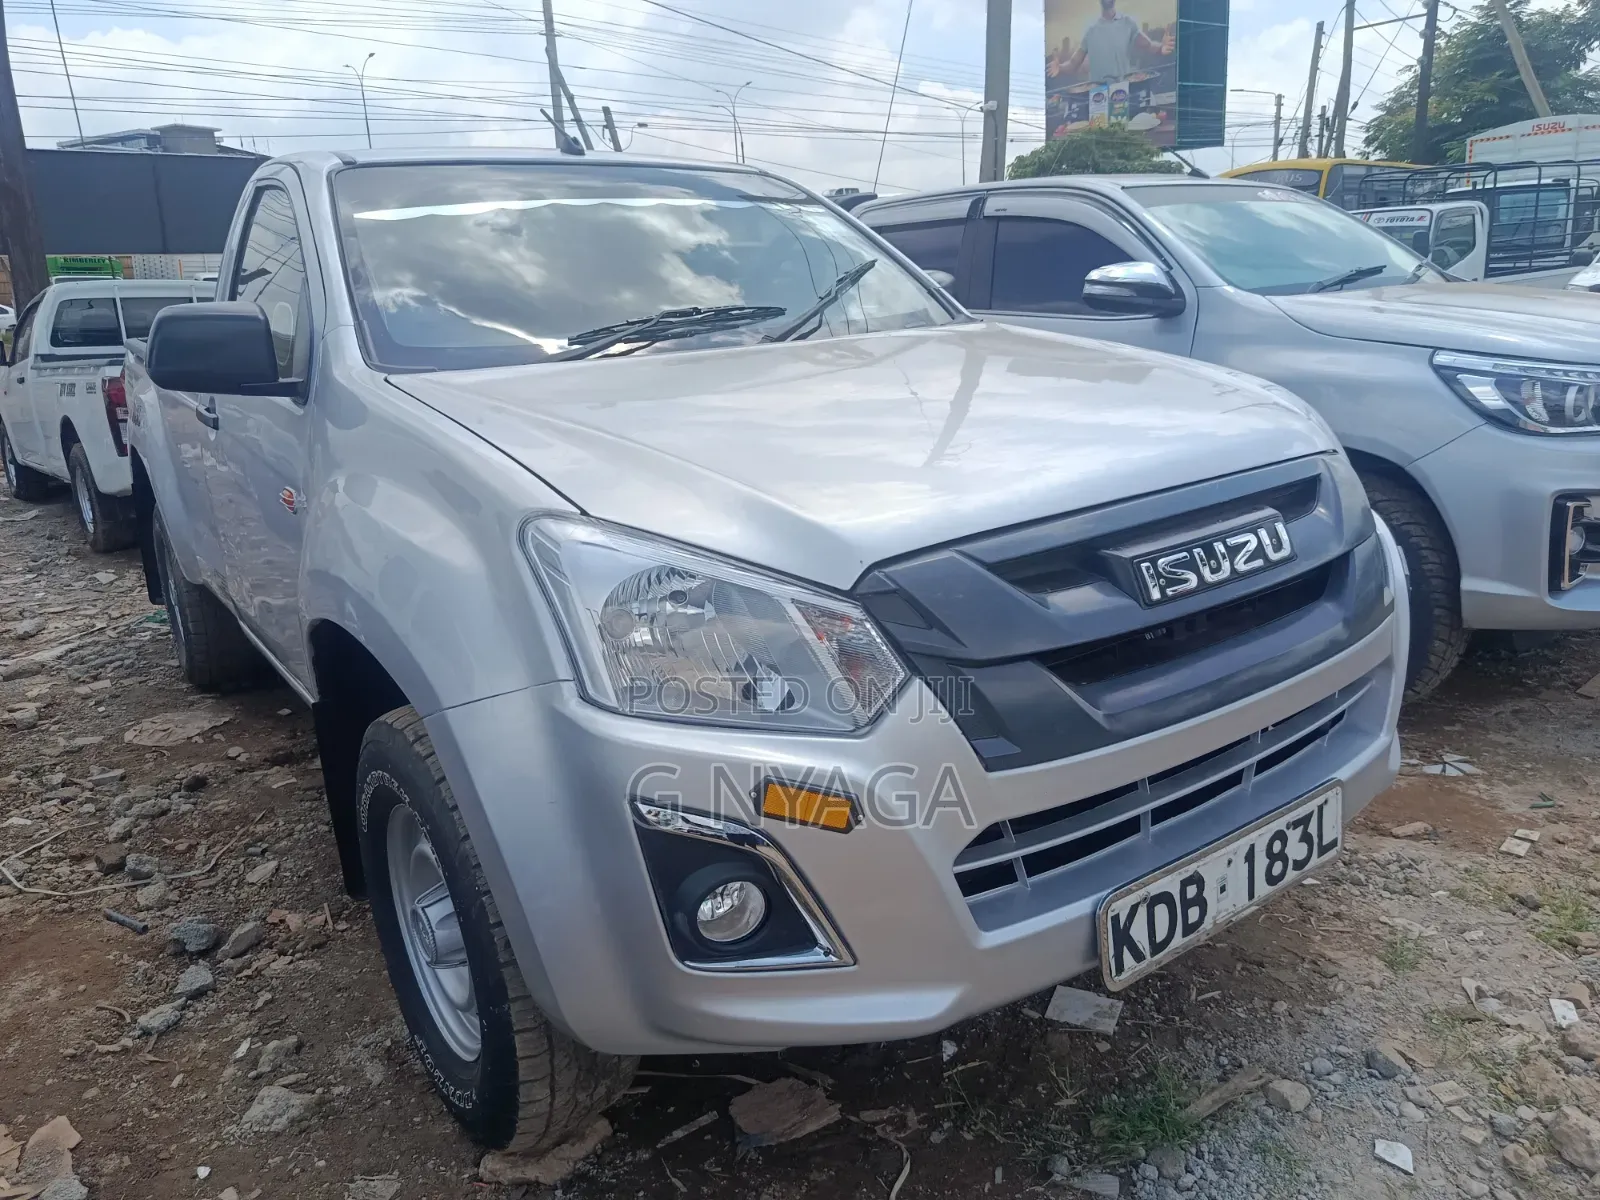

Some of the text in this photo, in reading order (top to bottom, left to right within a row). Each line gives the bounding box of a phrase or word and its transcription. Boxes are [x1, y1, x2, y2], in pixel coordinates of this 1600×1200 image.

[1531, 121, 1566, 132] ISUZU
[1139, 521, 1292, 602] ISUZU
[1111, 798, 1340, 978] KDB 183L
